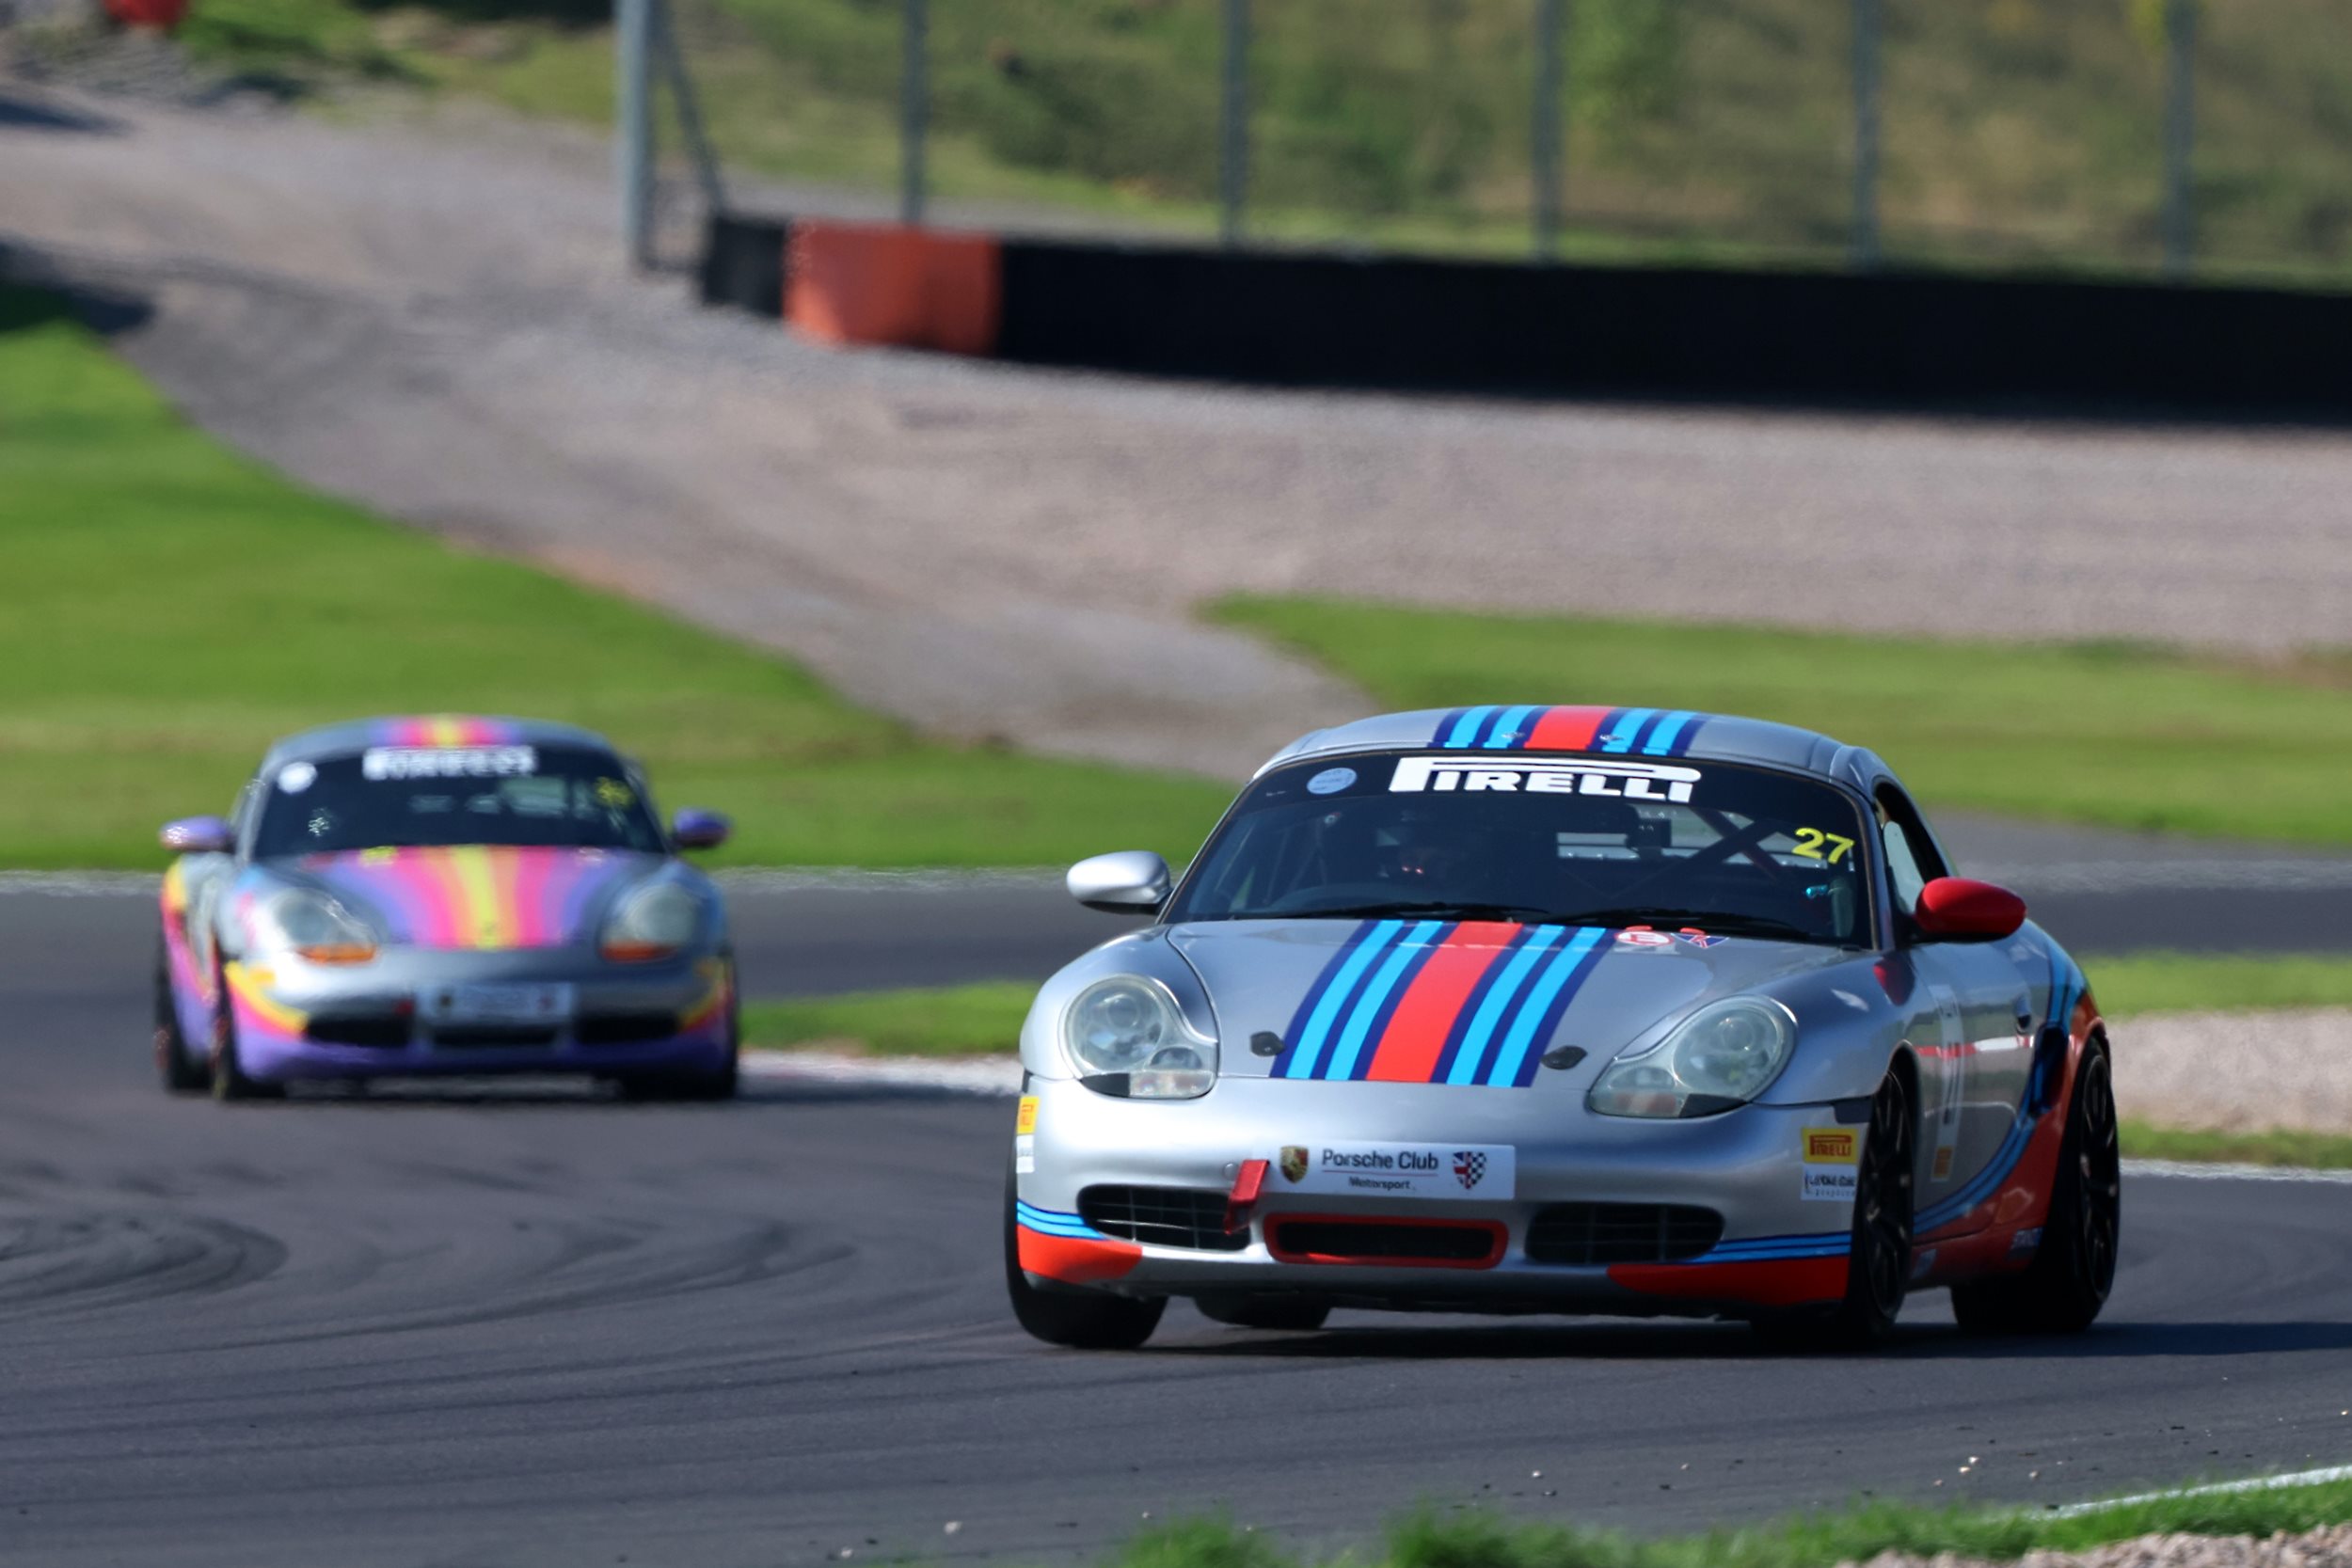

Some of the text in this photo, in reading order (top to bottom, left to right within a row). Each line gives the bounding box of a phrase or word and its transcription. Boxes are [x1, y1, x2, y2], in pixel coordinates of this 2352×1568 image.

[1389, 757, 1701, 803] PIRELLI
[1791, 827, 1855, 864] 27
[1809, 1134, 1852, 1156] PIRELLI
[1321, 1148, 1439, 1170] Porsche Club
[1348, 1176, 1411, 1191] Motorsport
